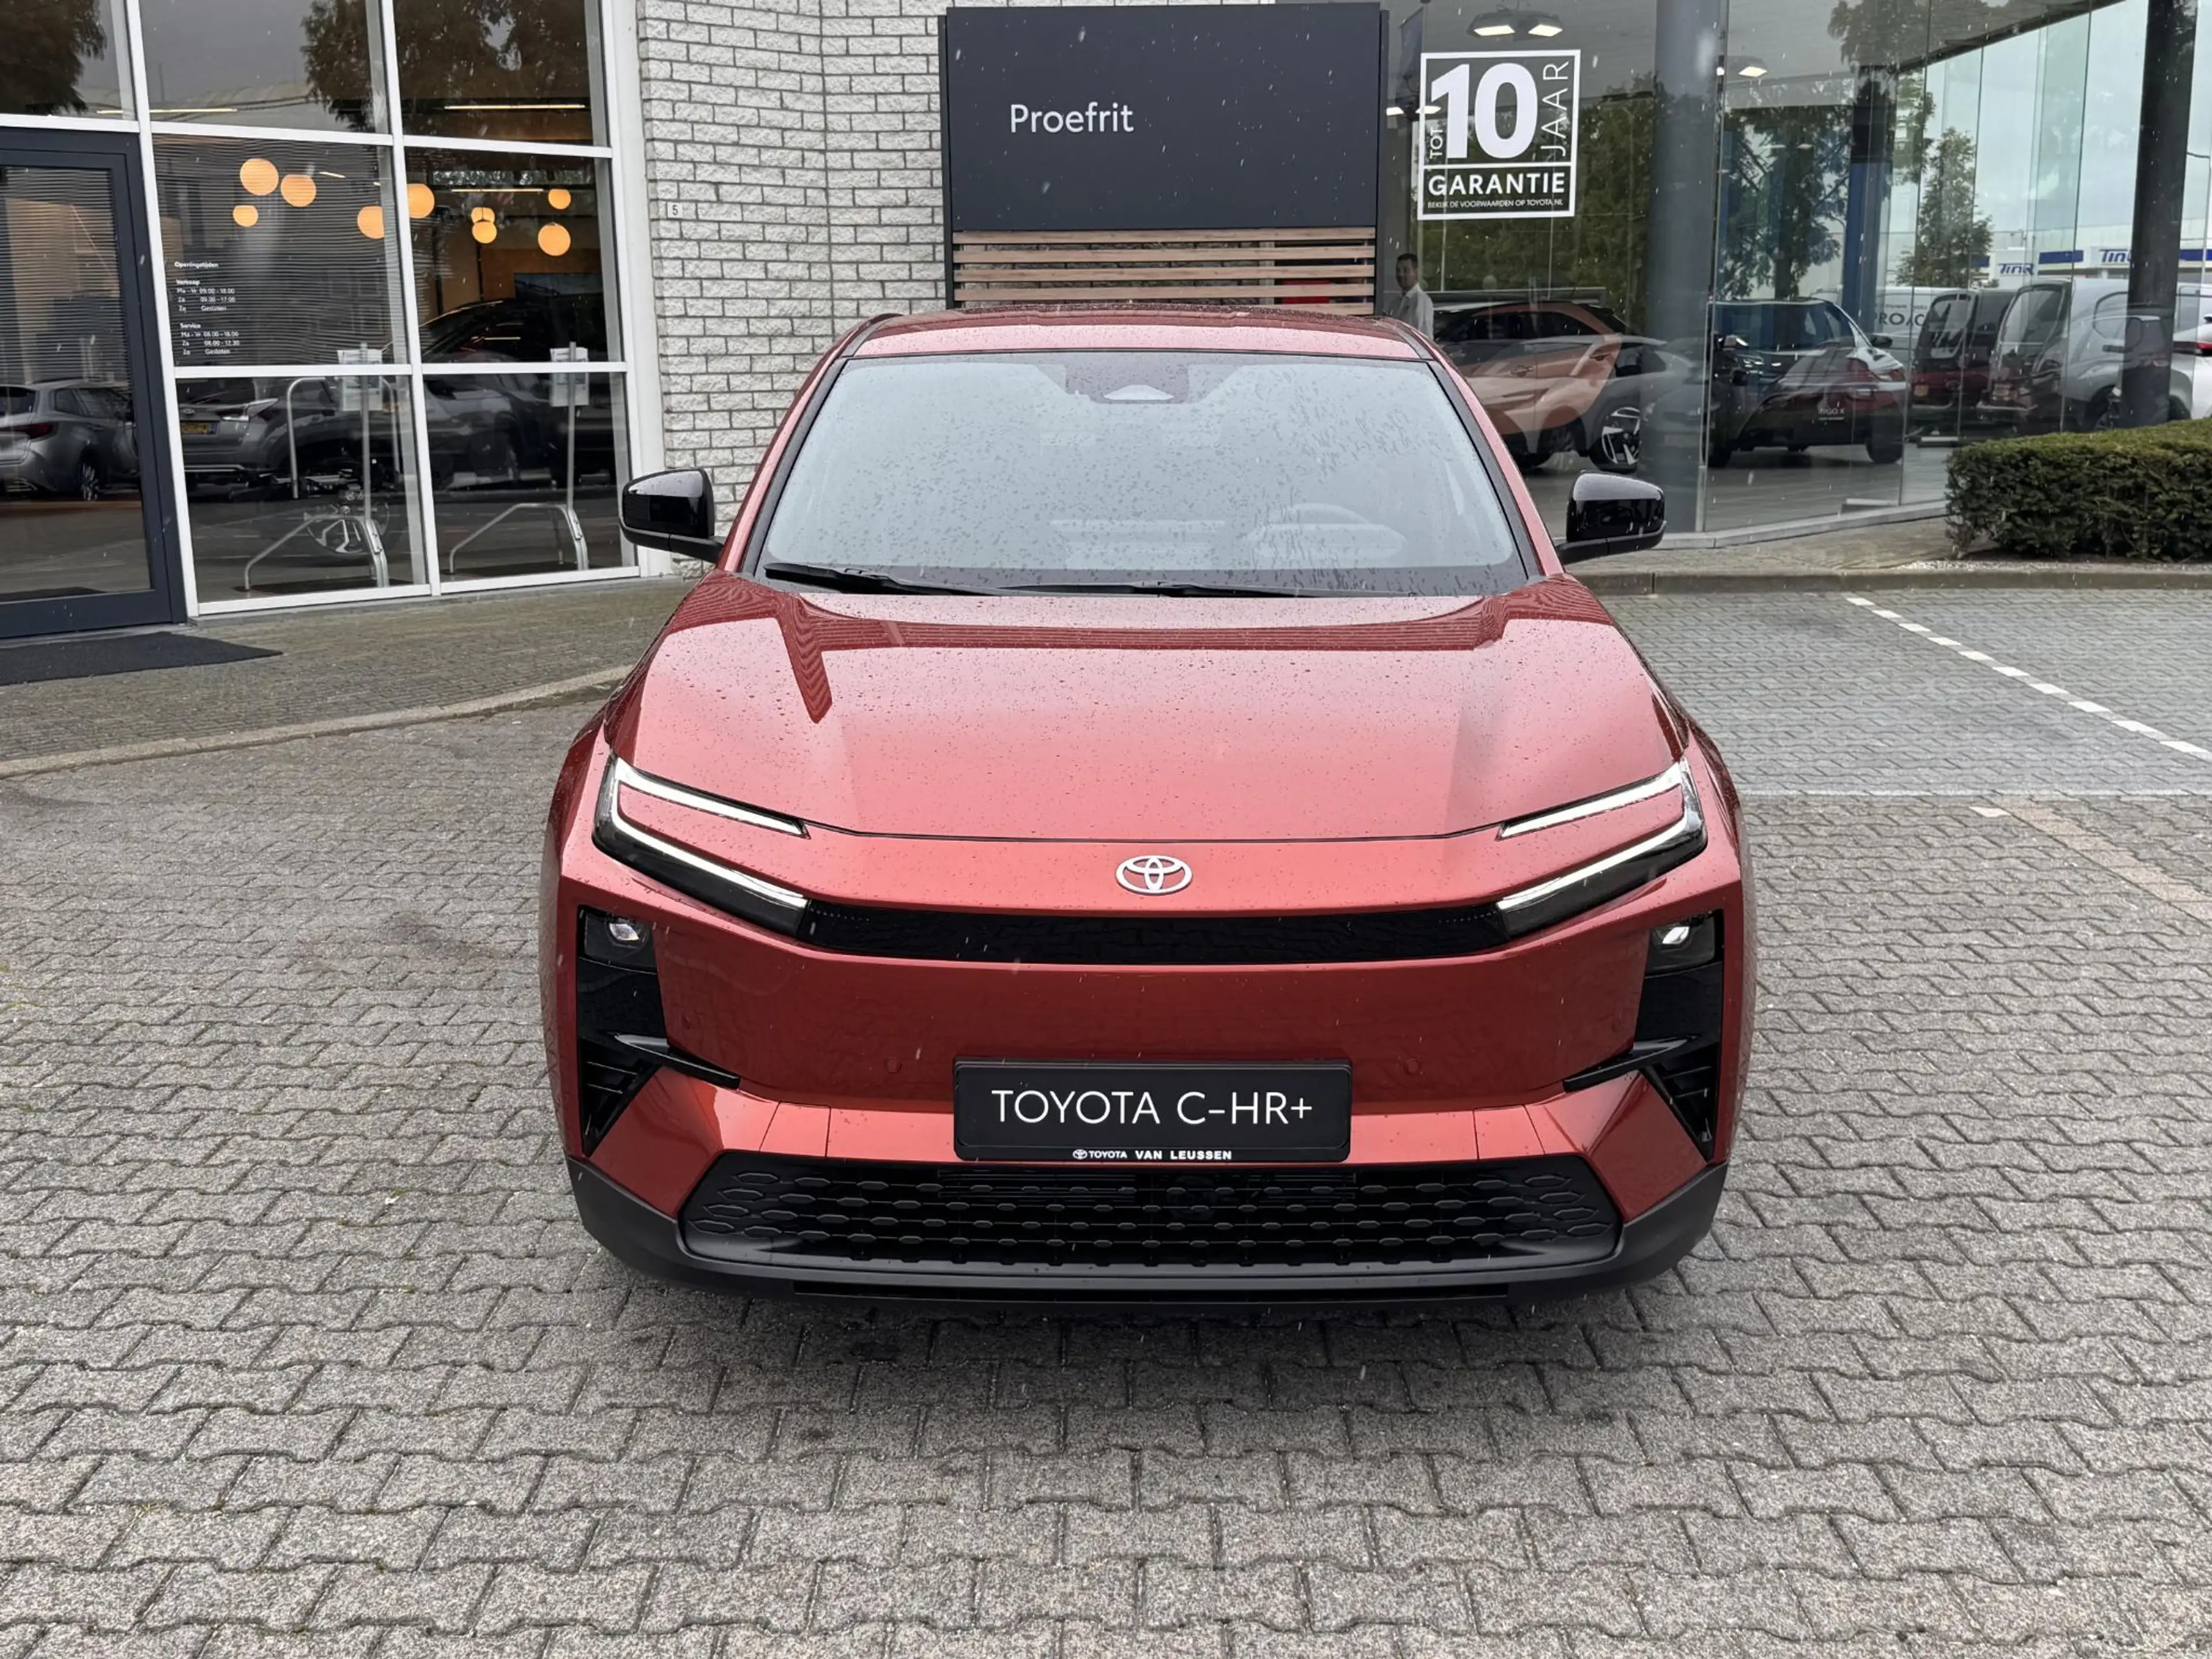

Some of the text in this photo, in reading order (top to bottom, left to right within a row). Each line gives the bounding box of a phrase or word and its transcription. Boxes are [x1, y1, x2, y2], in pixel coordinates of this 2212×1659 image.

[1010, 101, 1134, 133] Proefrit
[1430, 63, 1538, 159] 10
[1540, 61, 1570, 157] JAAR
[1429, 126, 1444, 160] TOT
[1428, 172, 1565, 196] GARANTIE
[672, 204, 678, 216] 5
[1460, 200, 1514, 208] VOORWAARDEN
[2099, 249, 2131, 263] Tin
[991, 1089, 1313, 1125] TOYOTA C-HR+
[1089, 1150, 1232, 1160] TOYOTA VAN LEUSSEN
